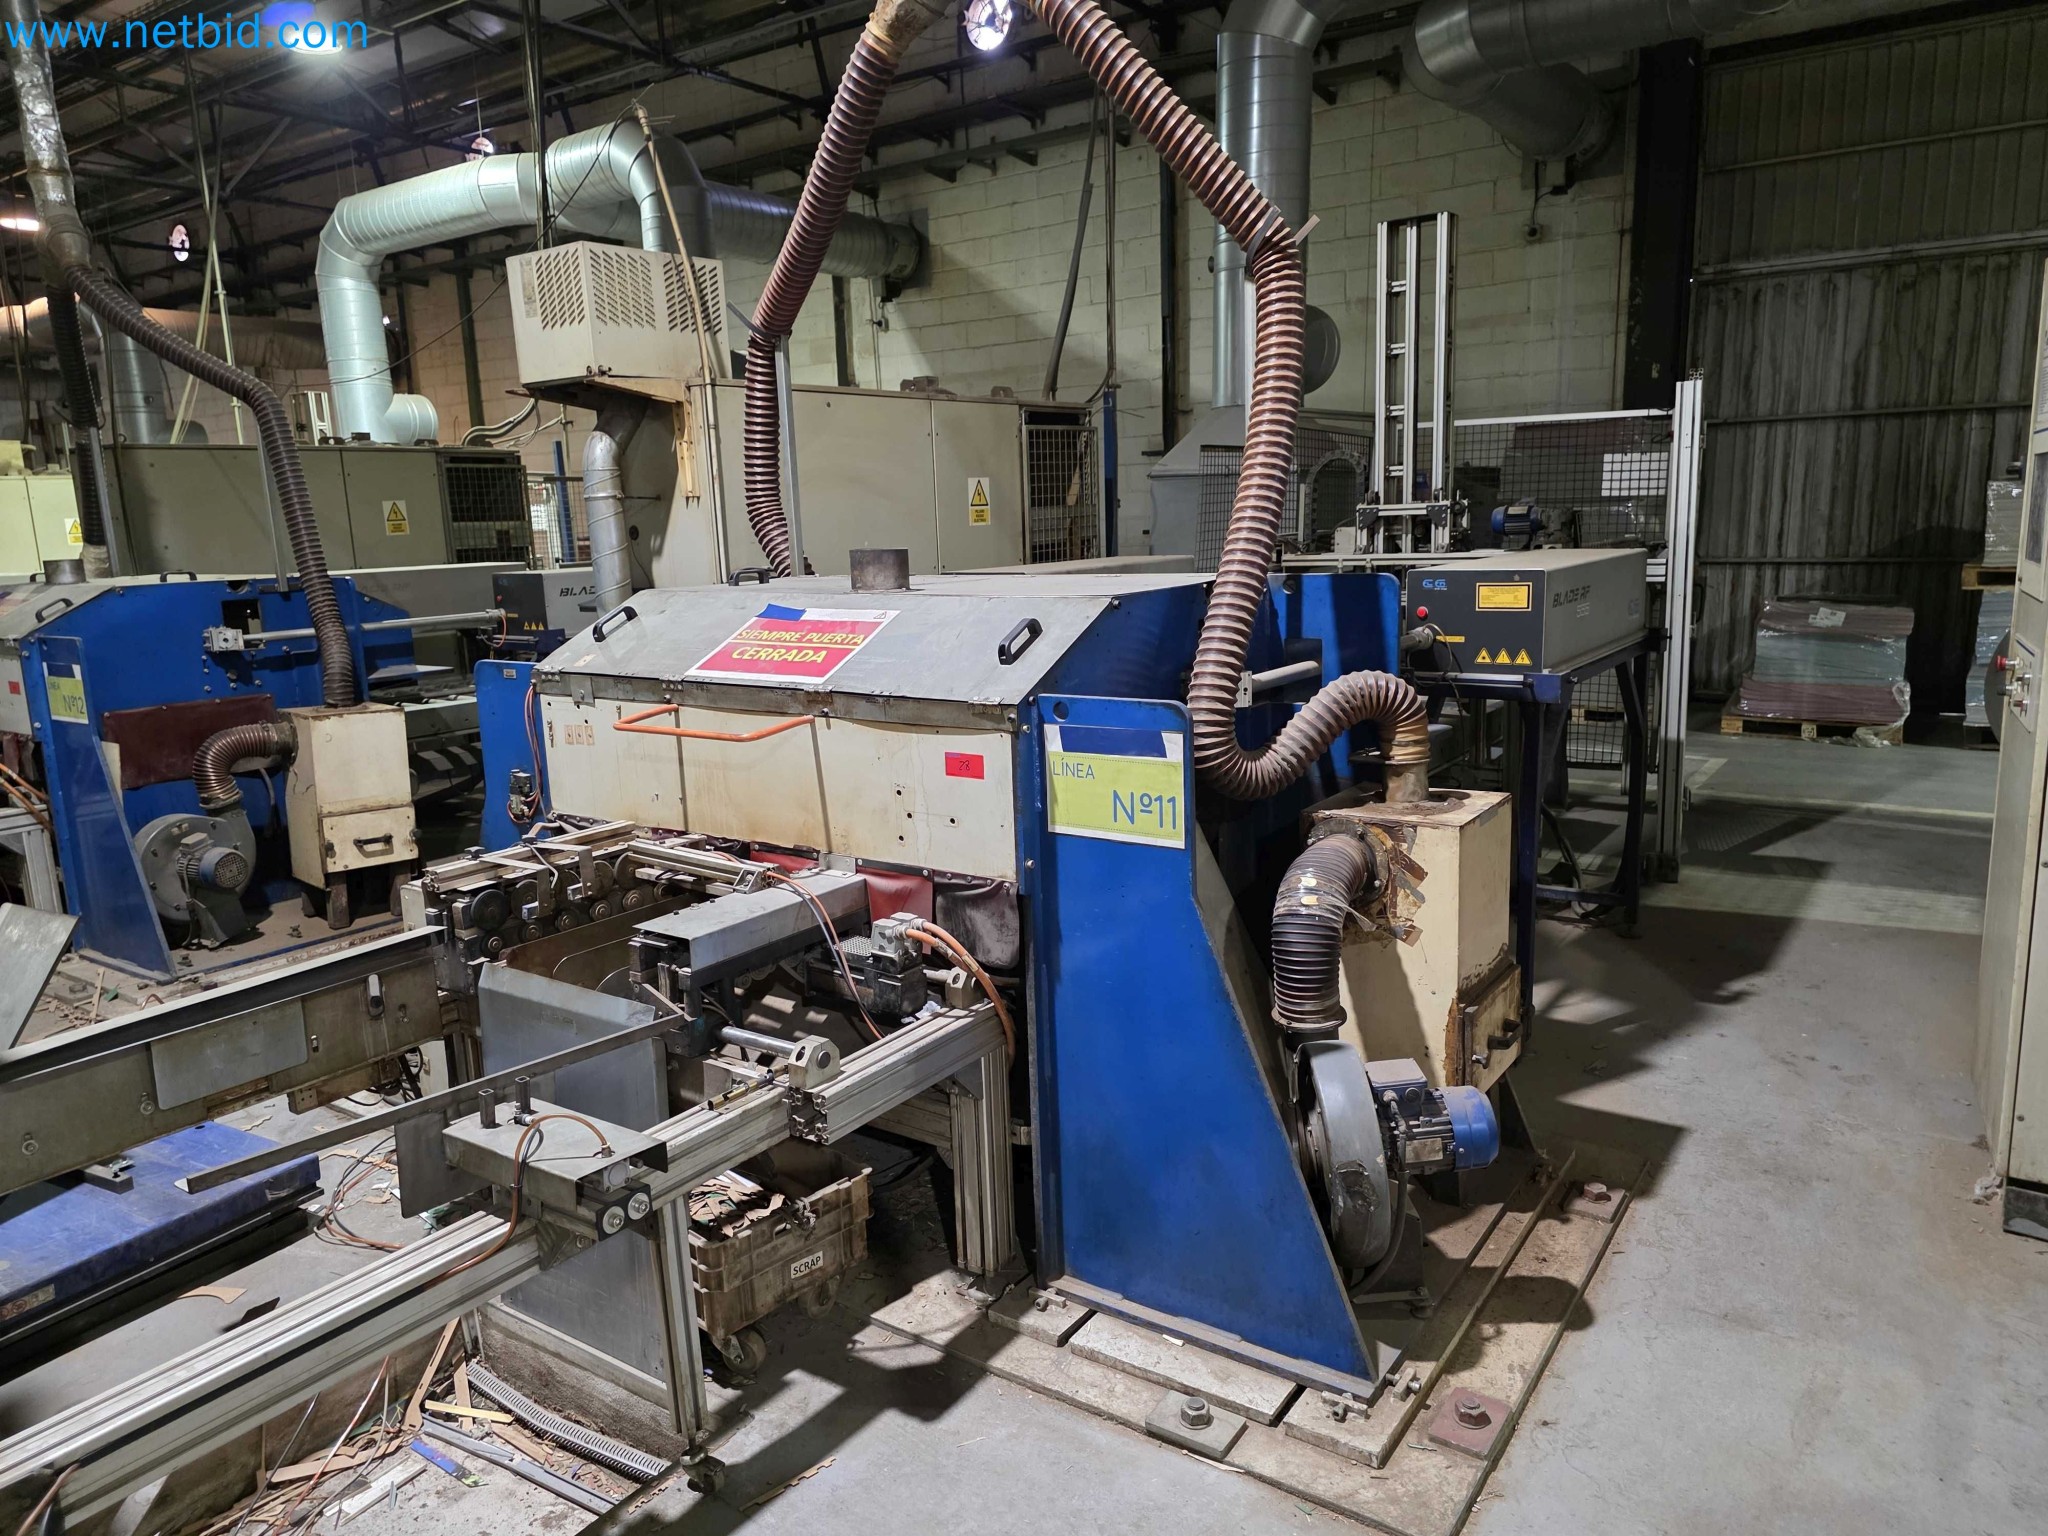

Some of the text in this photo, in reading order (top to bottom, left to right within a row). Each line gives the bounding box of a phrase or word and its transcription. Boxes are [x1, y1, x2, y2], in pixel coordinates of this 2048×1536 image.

[1552, 585, 1592, 608] BLADE RF
[736, 629, 865, 645] SIEMPRE PUERTA
[731, 646, 828, 664] CERRADA
[1052, 757, 1096, 780] LÍNEA
[792, 1255, 821, 1276] SCRAP
